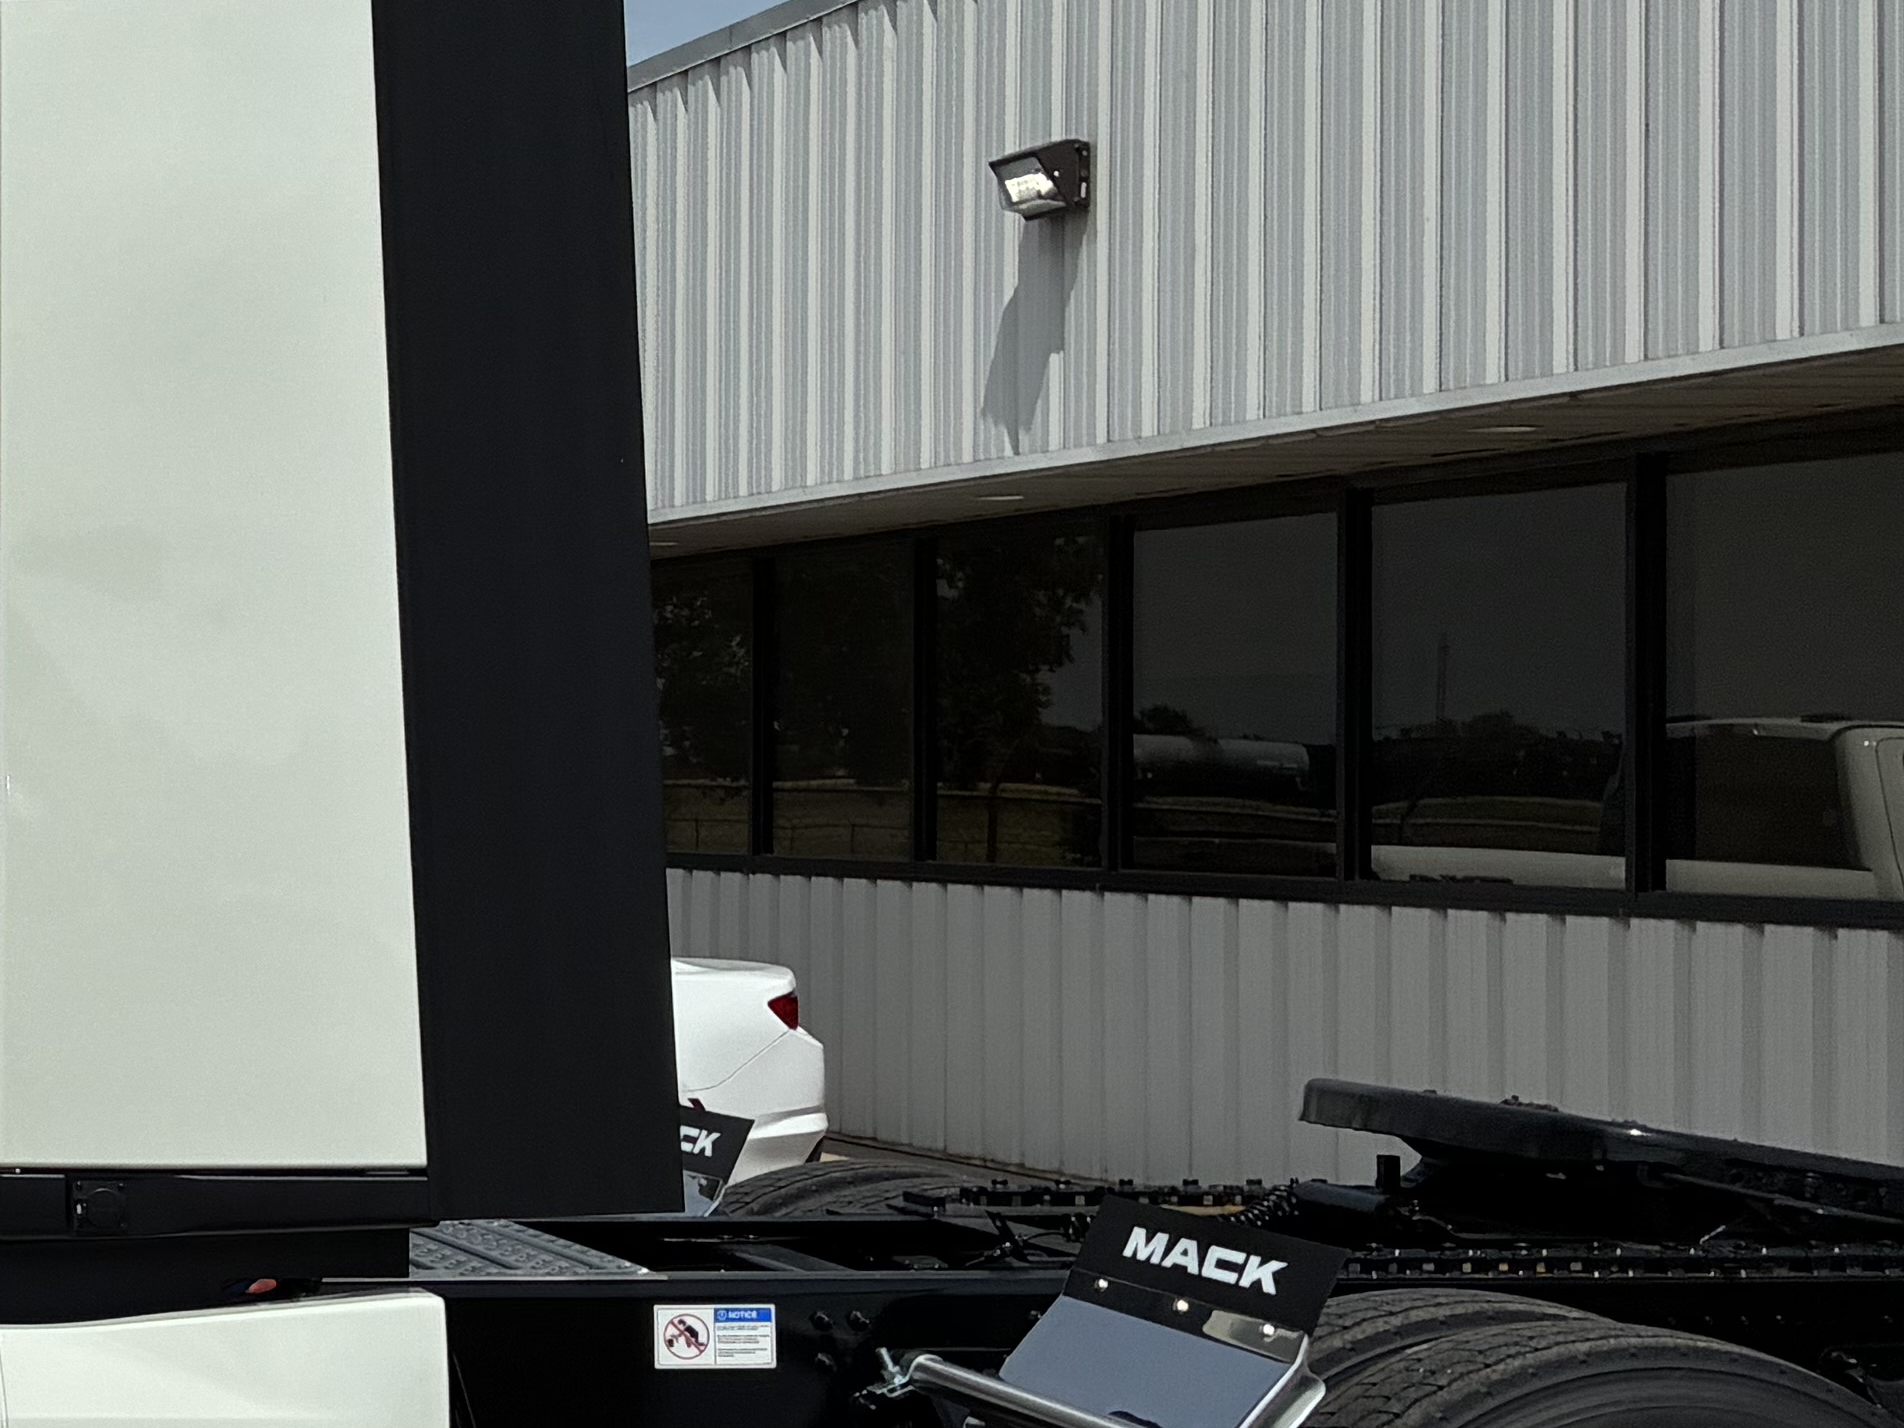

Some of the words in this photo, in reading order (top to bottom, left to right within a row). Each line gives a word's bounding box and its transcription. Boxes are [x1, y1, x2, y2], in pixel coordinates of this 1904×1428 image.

[680, 1125, 721, 1158] CK
[1122, 1225, 1289, 1296] MACK
[728, 1310, 758, 1319] NOTICE
